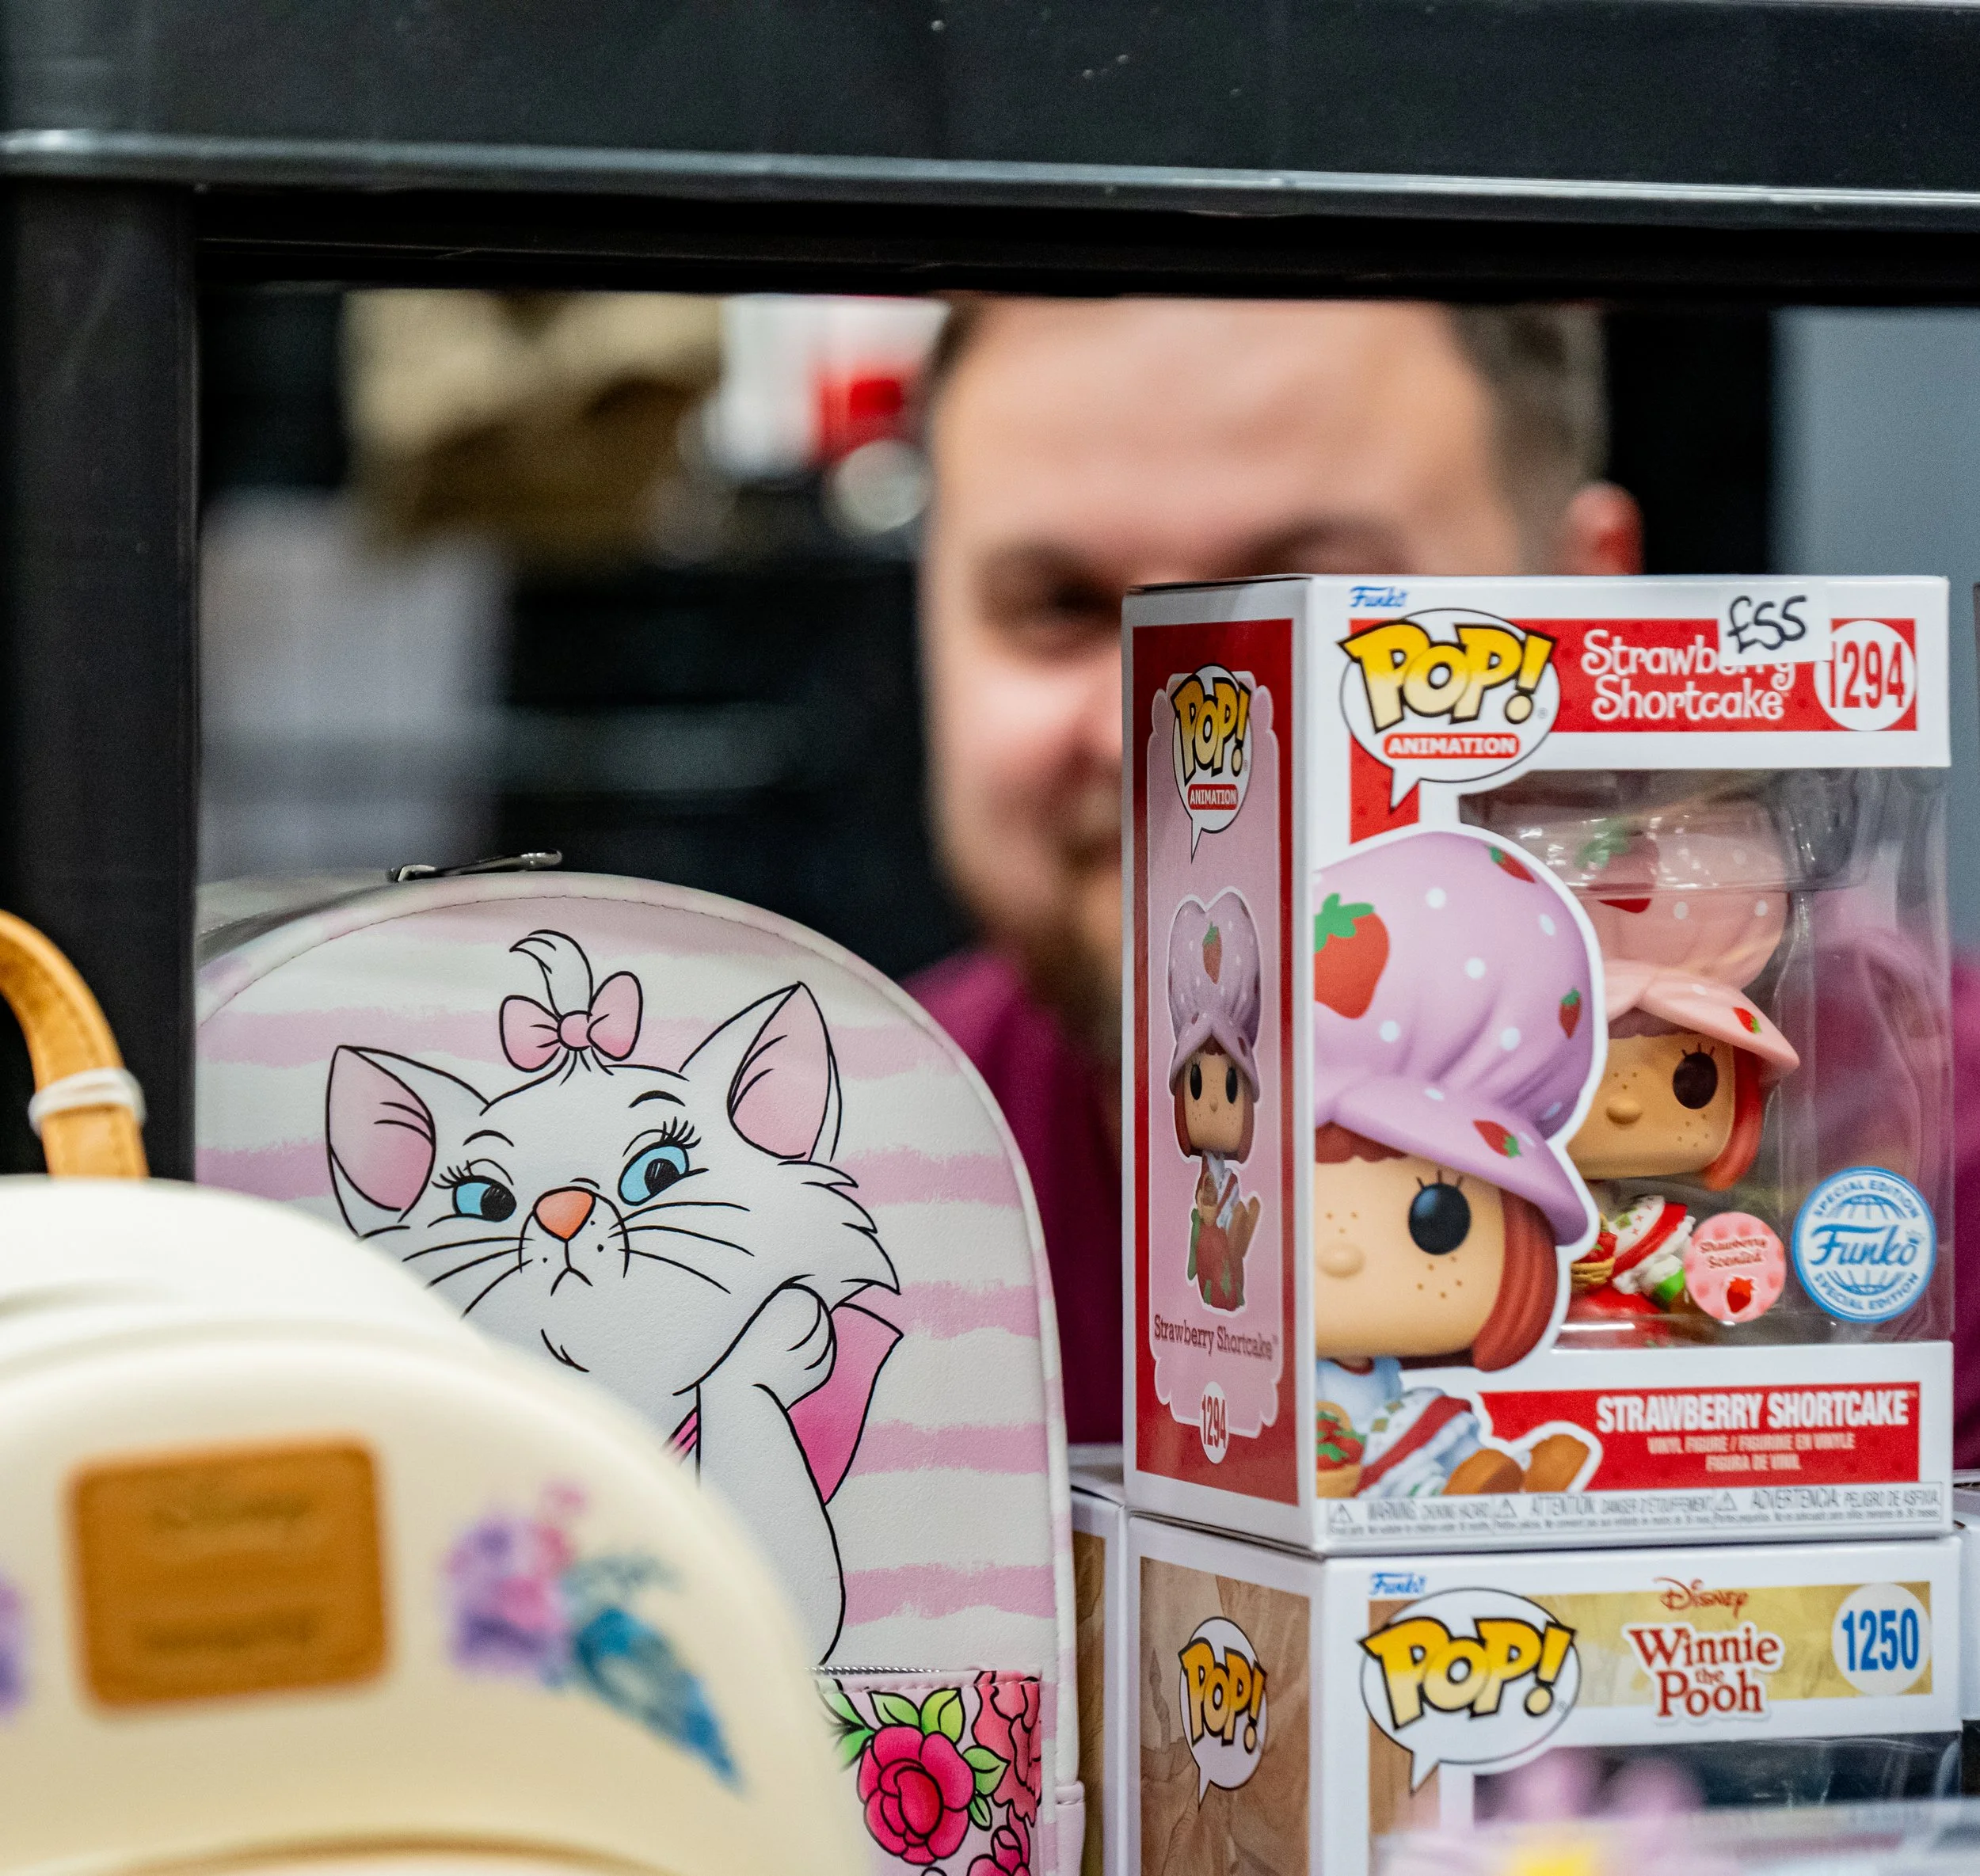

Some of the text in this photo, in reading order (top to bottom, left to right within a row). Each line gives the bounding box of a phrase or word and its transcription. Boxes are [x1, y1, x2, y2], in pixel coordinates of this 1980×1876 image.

[1727, 595, 1807, 654] £55
[1335, 618, 1557, 735] POP!
[1581, 629, 1796, 691] Strawby
[1828, 640, 1906, 710] 1294
[1590, 674, 1784, 721] Shortcake
[1170, 673, 1252, 787] POP!
[1388, 737, 1517, 755] ANIMATION
[1190, 789, 1238, 805] ANIMATION
[1809, 1223, 1921, 1267] Funko
[1154, 1314, 1215, 1357] Strawberry
[1201, 1394, 1227, 1449] 1294
[1595, 1389, 1910, 1433] STRAWBERRY SHORTCAKE
[1628, 1626, 1780, 1668] Winnie
[1841, 1608, 1920, 1672] 1250
[1177, 1636, 1267, 1755] POP!
[1356, 1615, 1577, 1731] POP!
[1657, 1669, 1764, 1718] Pooh
[1695, 1667, 1725, 1685] the
